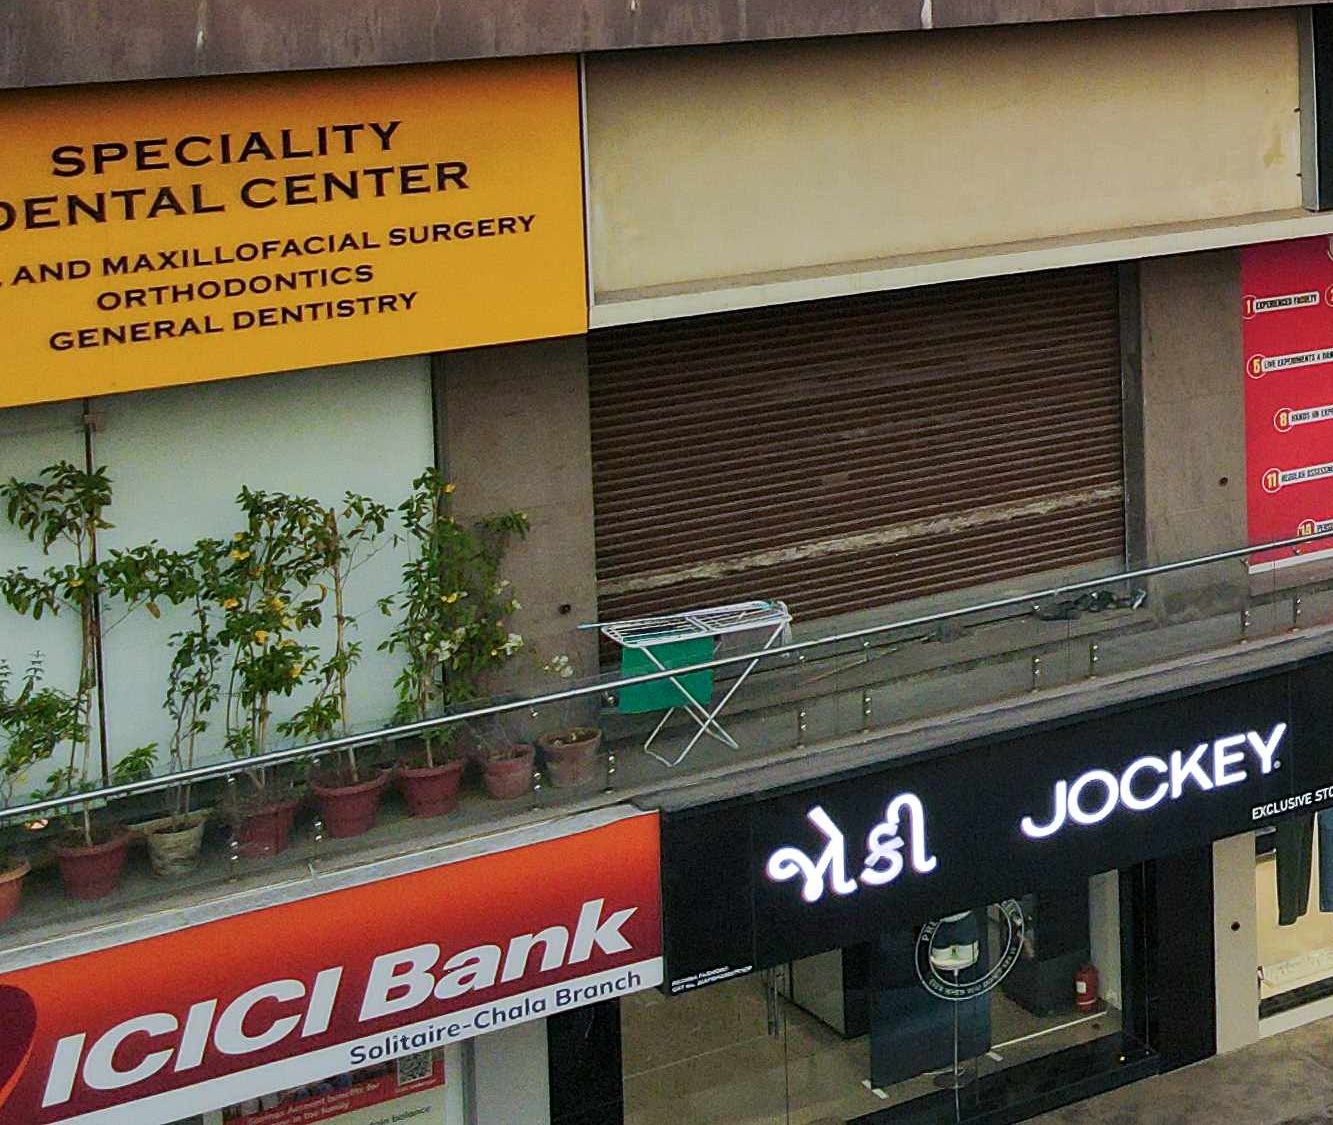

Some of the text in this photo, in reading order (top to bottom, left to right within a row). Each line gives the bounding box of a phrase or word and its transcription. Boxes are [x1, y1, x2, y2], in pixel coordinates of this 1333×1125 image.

[50, 121, 402, 178] SPECIALITY
[240, 161, 470, 210] CENTER
[13, 214, 537, 287] AND MAXILLOFACIAL SURGERY
[96, 264, 374, 313] ORTHODONTICS
[49, 291, 419, 353] GENERAL DENTISTRY
[1251, 793, 1313, 820] EXCLUSIVE
[40, 897, 639, 1109] ICICI Bank
[349, 994, 548, 1066] Solitaire-Chala
[555, 970, 642, 1007] Branch
